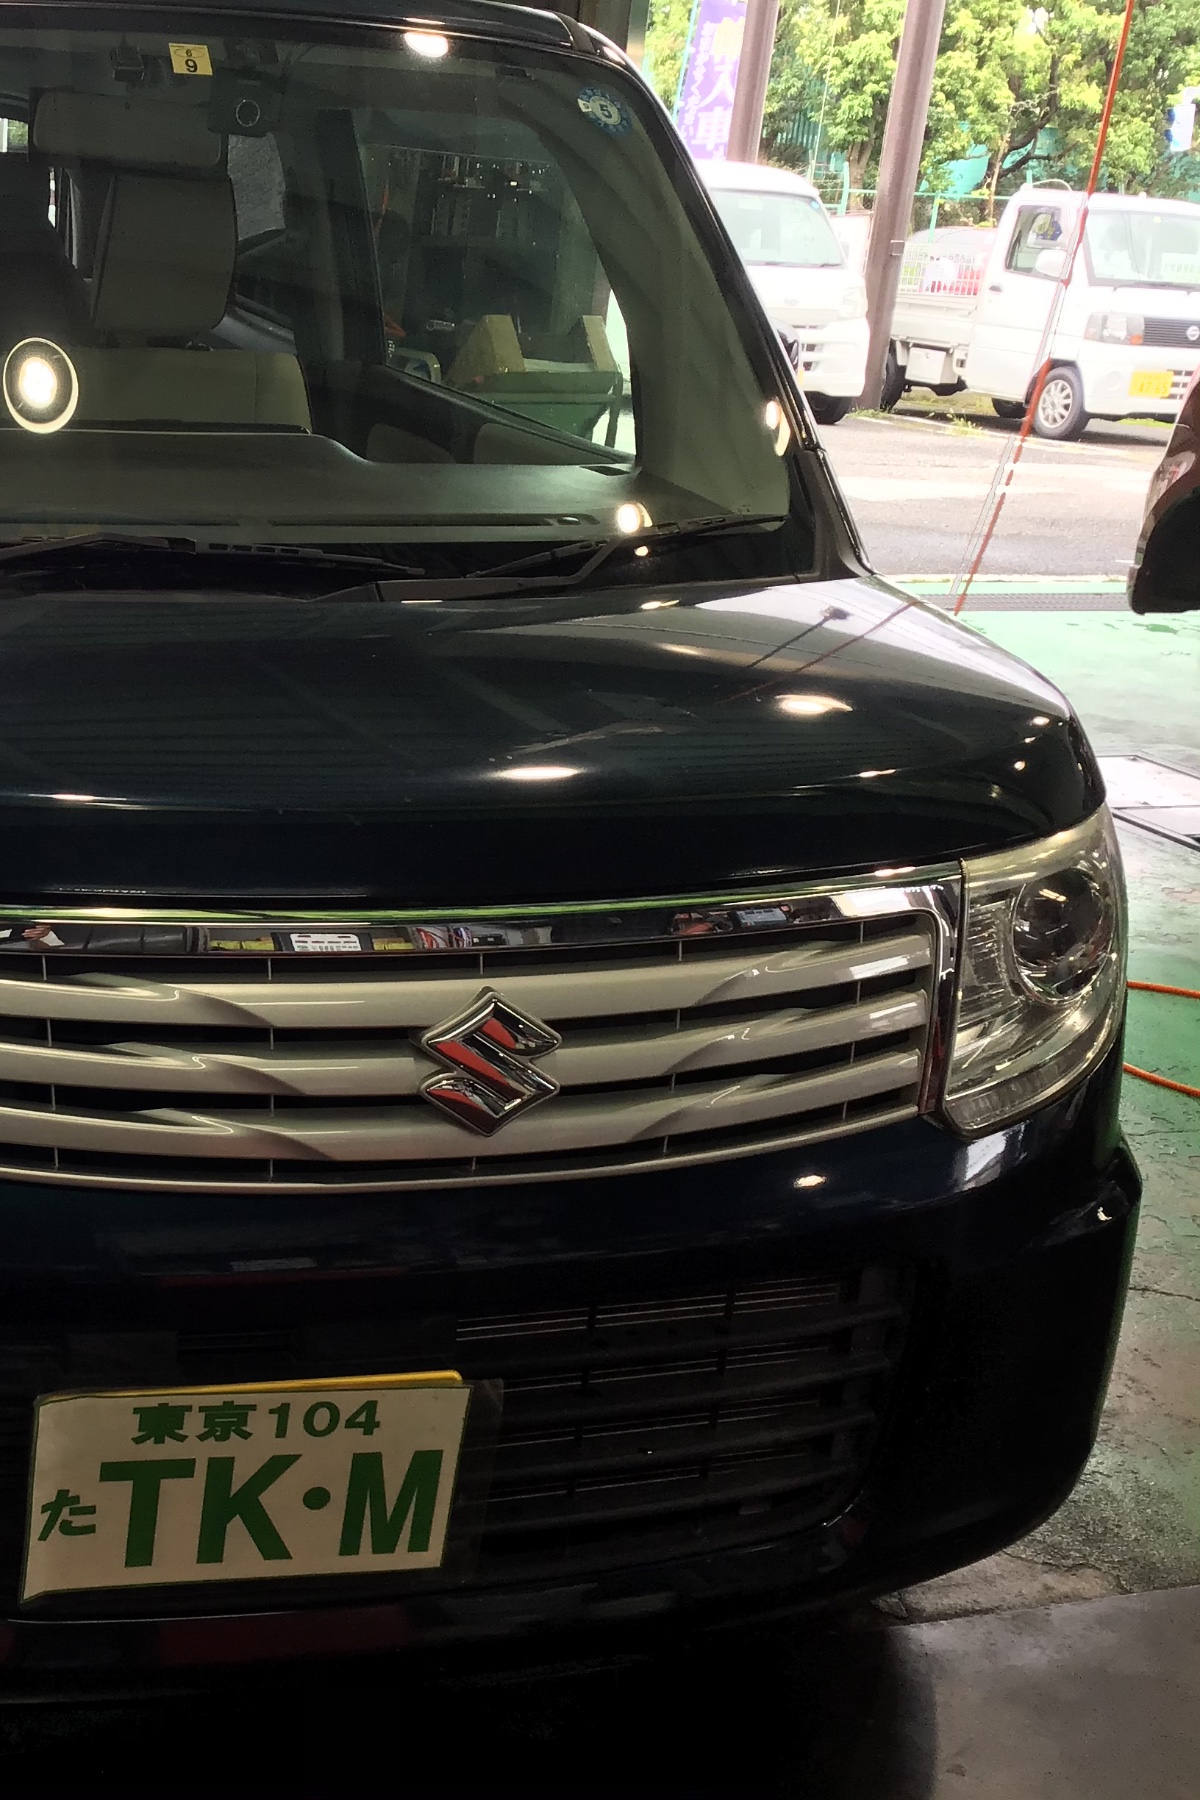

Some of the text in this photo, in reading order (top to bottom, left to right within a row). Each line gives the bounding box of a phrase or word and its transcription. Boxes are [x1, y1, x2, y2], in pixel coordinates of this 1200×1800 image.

[184, 58, 198, 73] 9
[598, 102, 613, 119] 5
[37, 1488, 97, 1542] た
